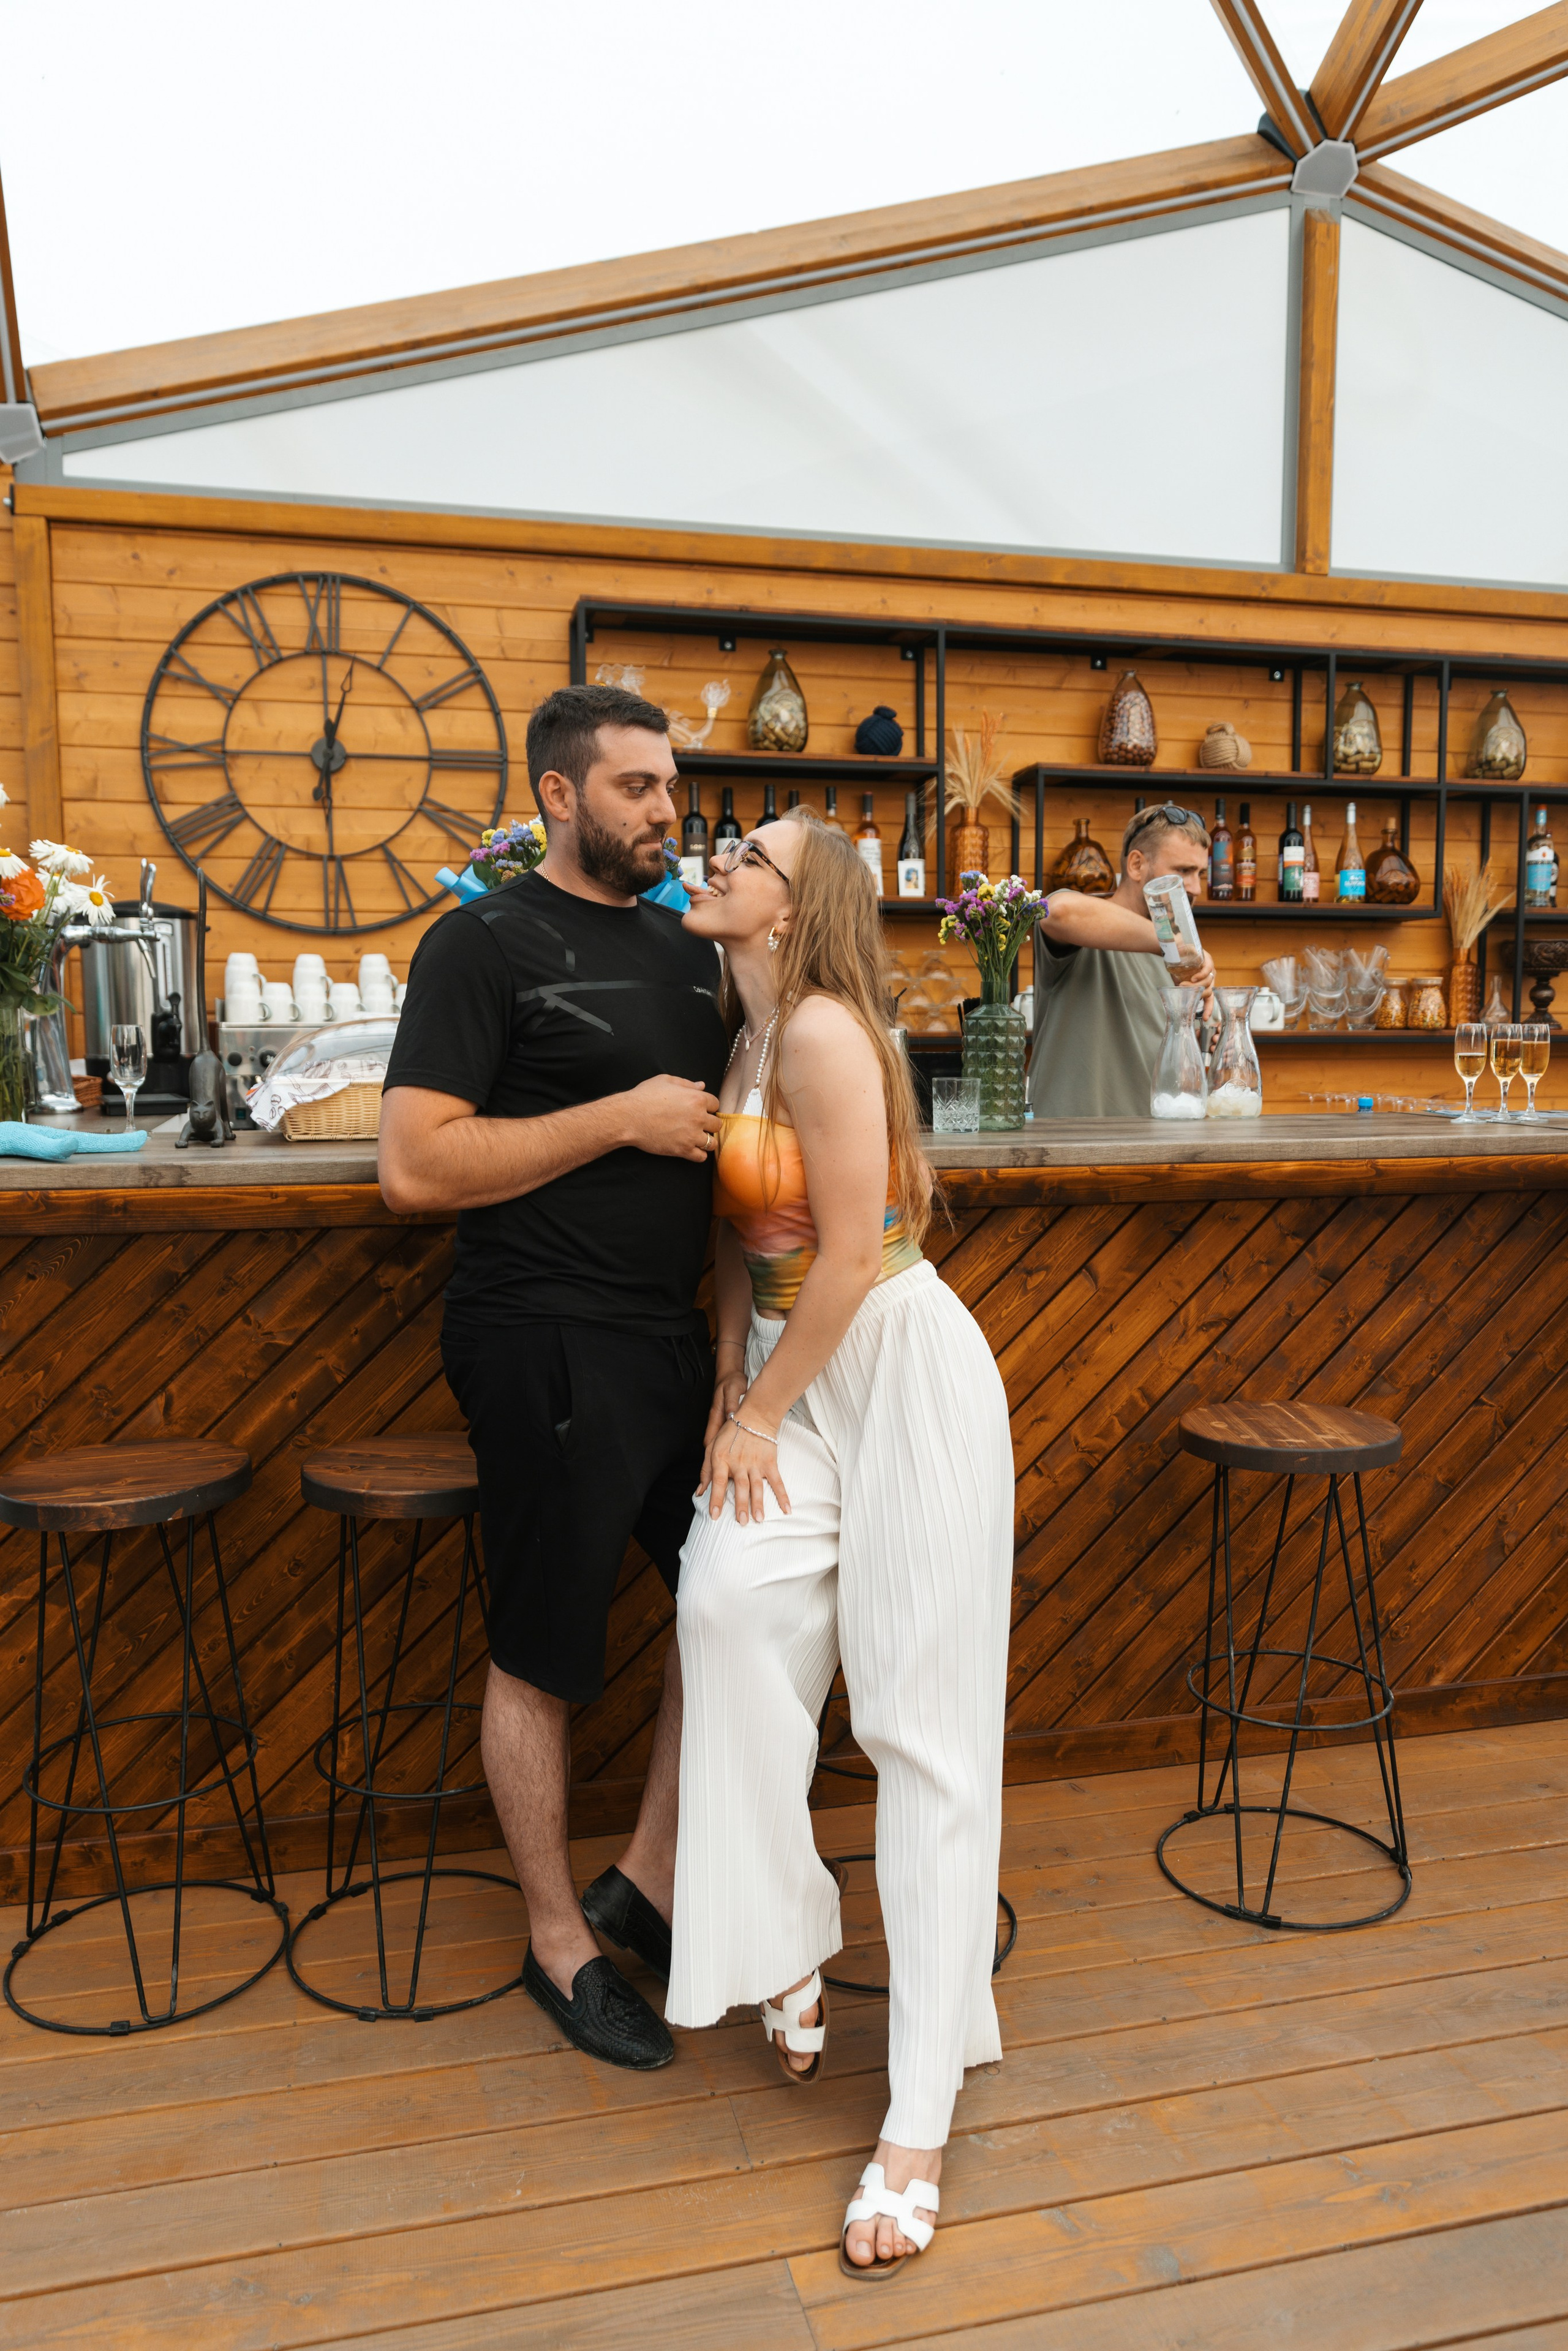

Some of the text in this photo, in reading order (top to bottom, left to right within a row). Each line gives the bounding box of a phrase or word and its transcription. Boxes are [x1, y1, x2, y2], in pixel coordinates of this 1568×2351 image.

[217, 585, 282, 670] XI
[298, 574, 341, 653] XII
[377, 603, 415, 669] I
[159, 647, 239, 709] X
[415, 663, 484, 712] II
[146, 731, 225, 769] IX
[431, 749, 505, 770] III
[167, 791, 247, 864] VIII
[231, 834, 287, 916] VII
[322, 854, 358, 929] VI
[382, 843, 431, 910] V
